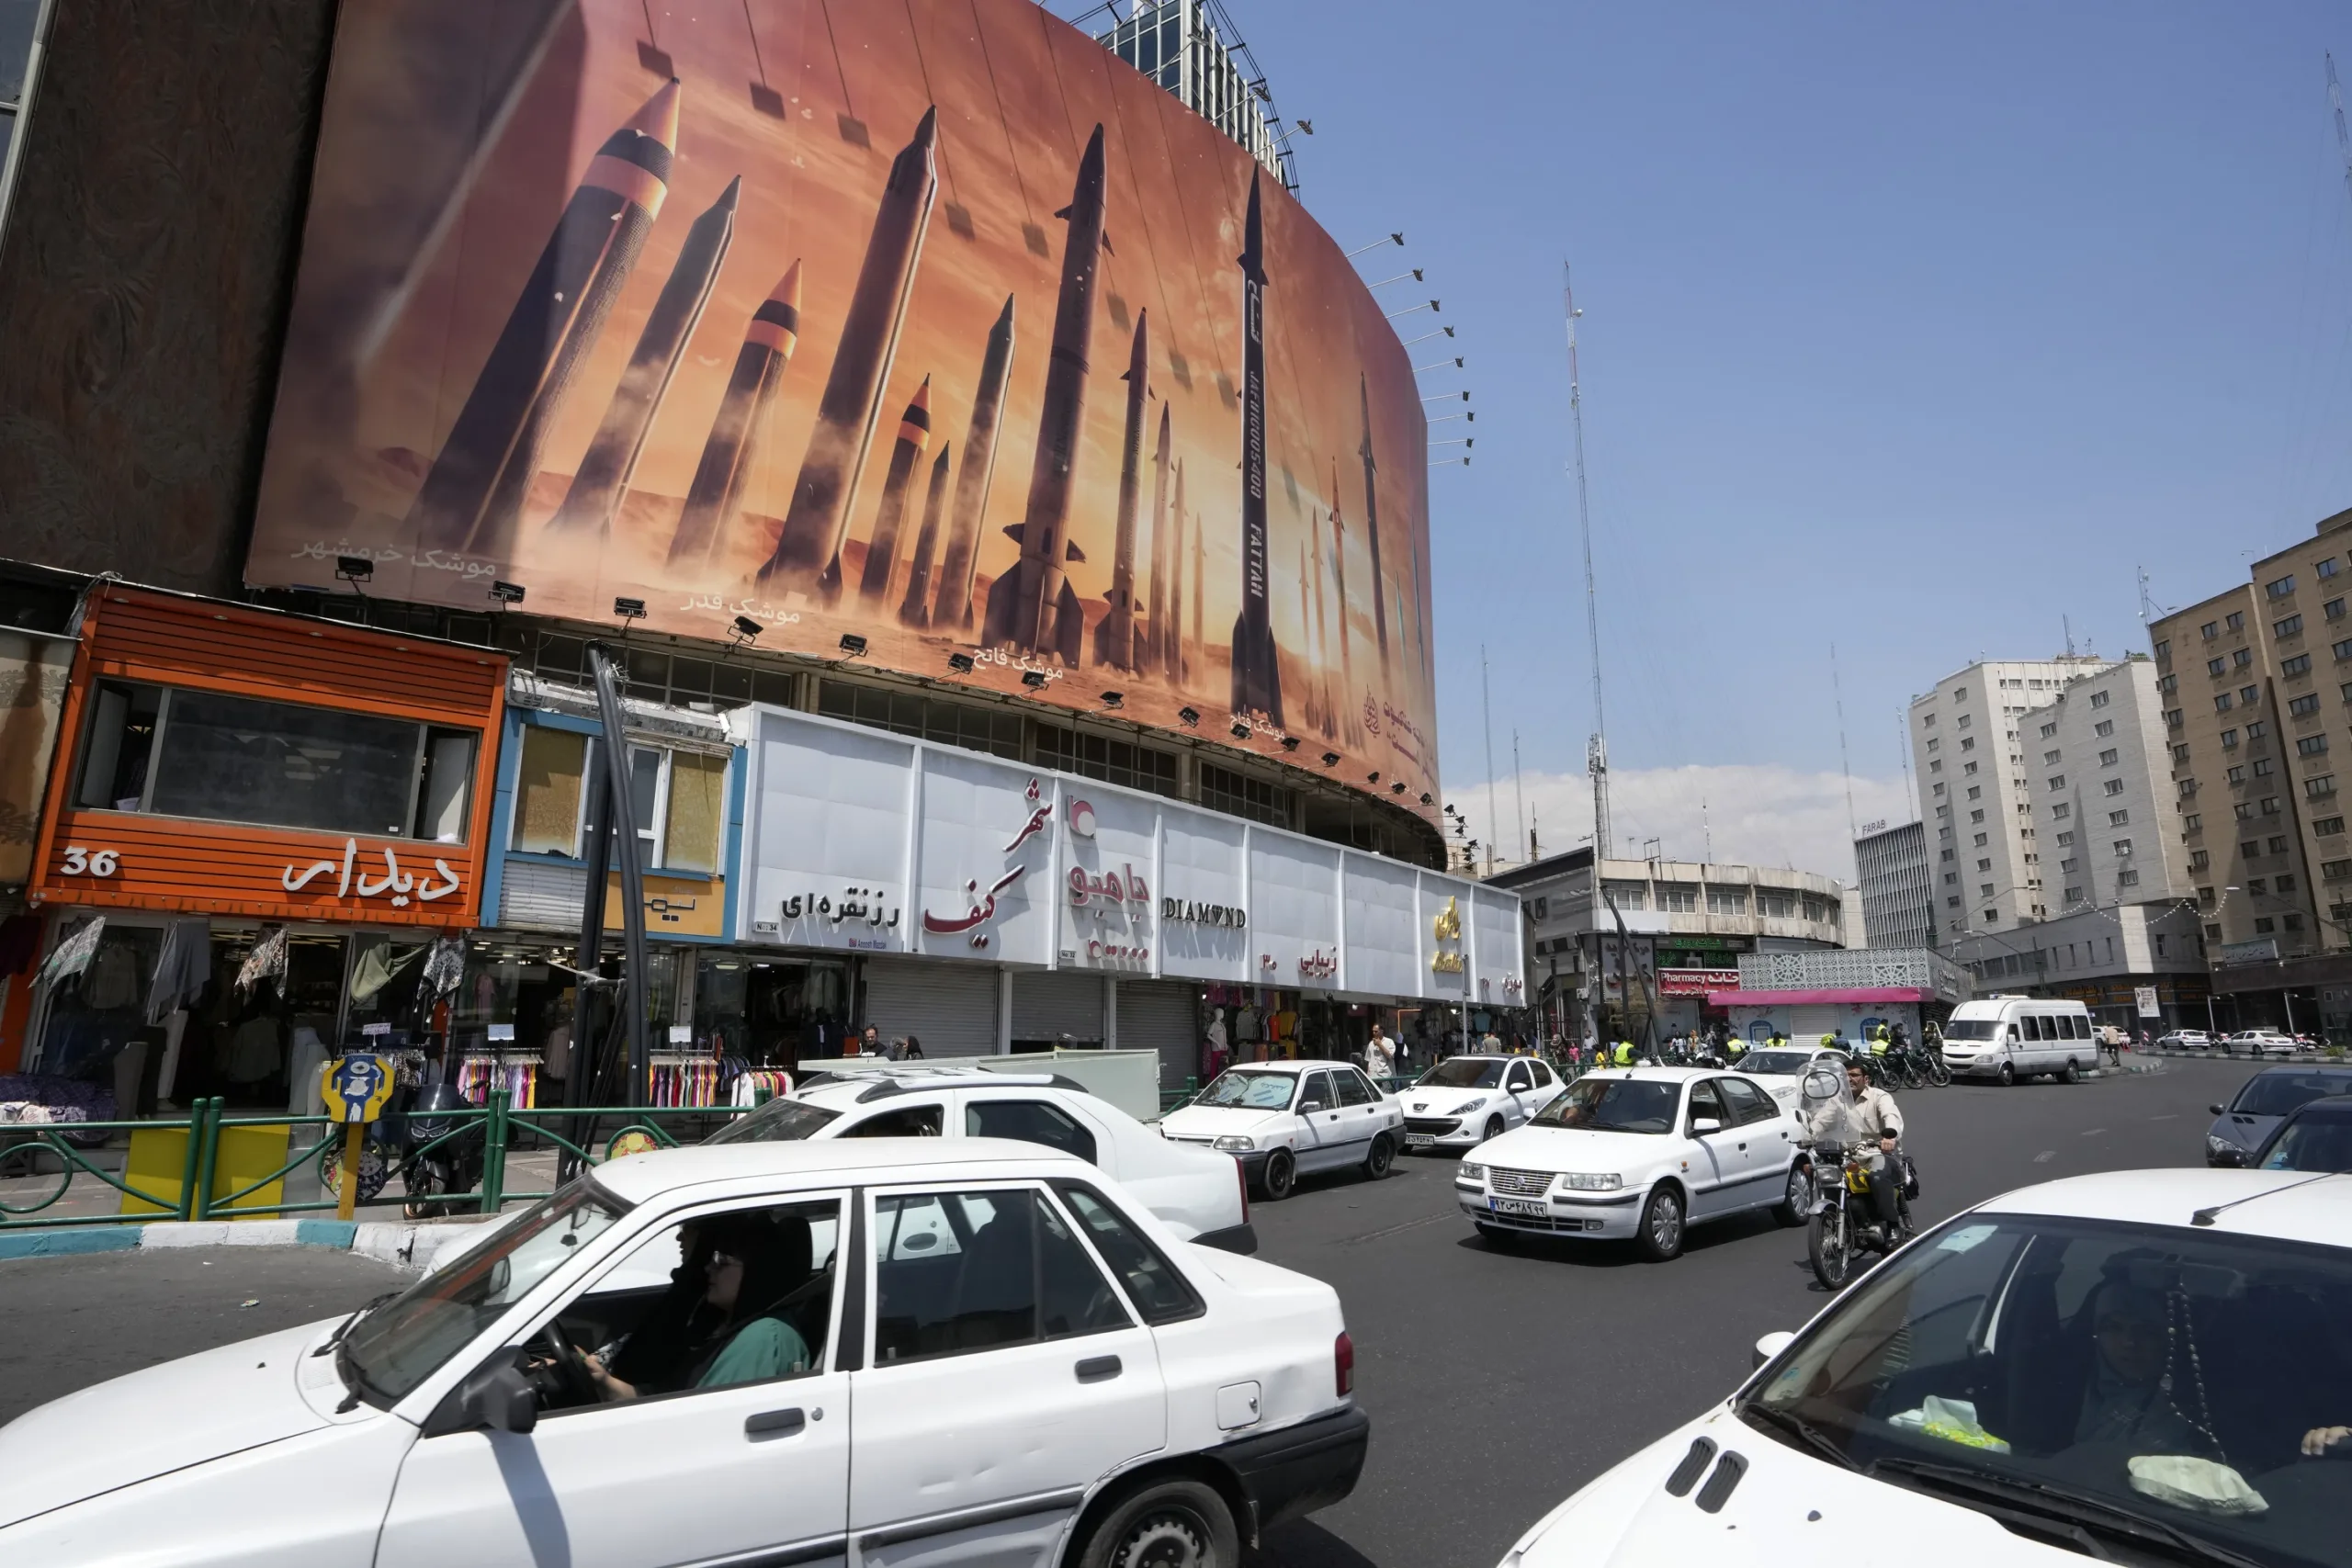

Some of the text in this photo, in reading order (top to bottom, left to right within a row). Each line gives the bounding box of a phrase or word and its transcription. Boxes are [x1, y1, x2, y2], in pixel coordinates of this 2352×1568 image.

[290, 537, 496, 580] موشک خرمشهر
[1250, 523, 1264, 599] FATTAH
[680, 592, 800, 626] موشک قدر
[973, 647, 1063, 682] موشک فاتح
[1230, 711, 1285, 741] موشک فتاح
[1862, 818, 1886, 836] FARAB
[60, 845, 120, 877] 36
[281, 837, 460, 908] دیدار
[924, 777, 1053, 949] شهر کیف
[1299, 946, 1338, 978] زیبایی
[1660, 972, 1706, 984] Pharmacy
